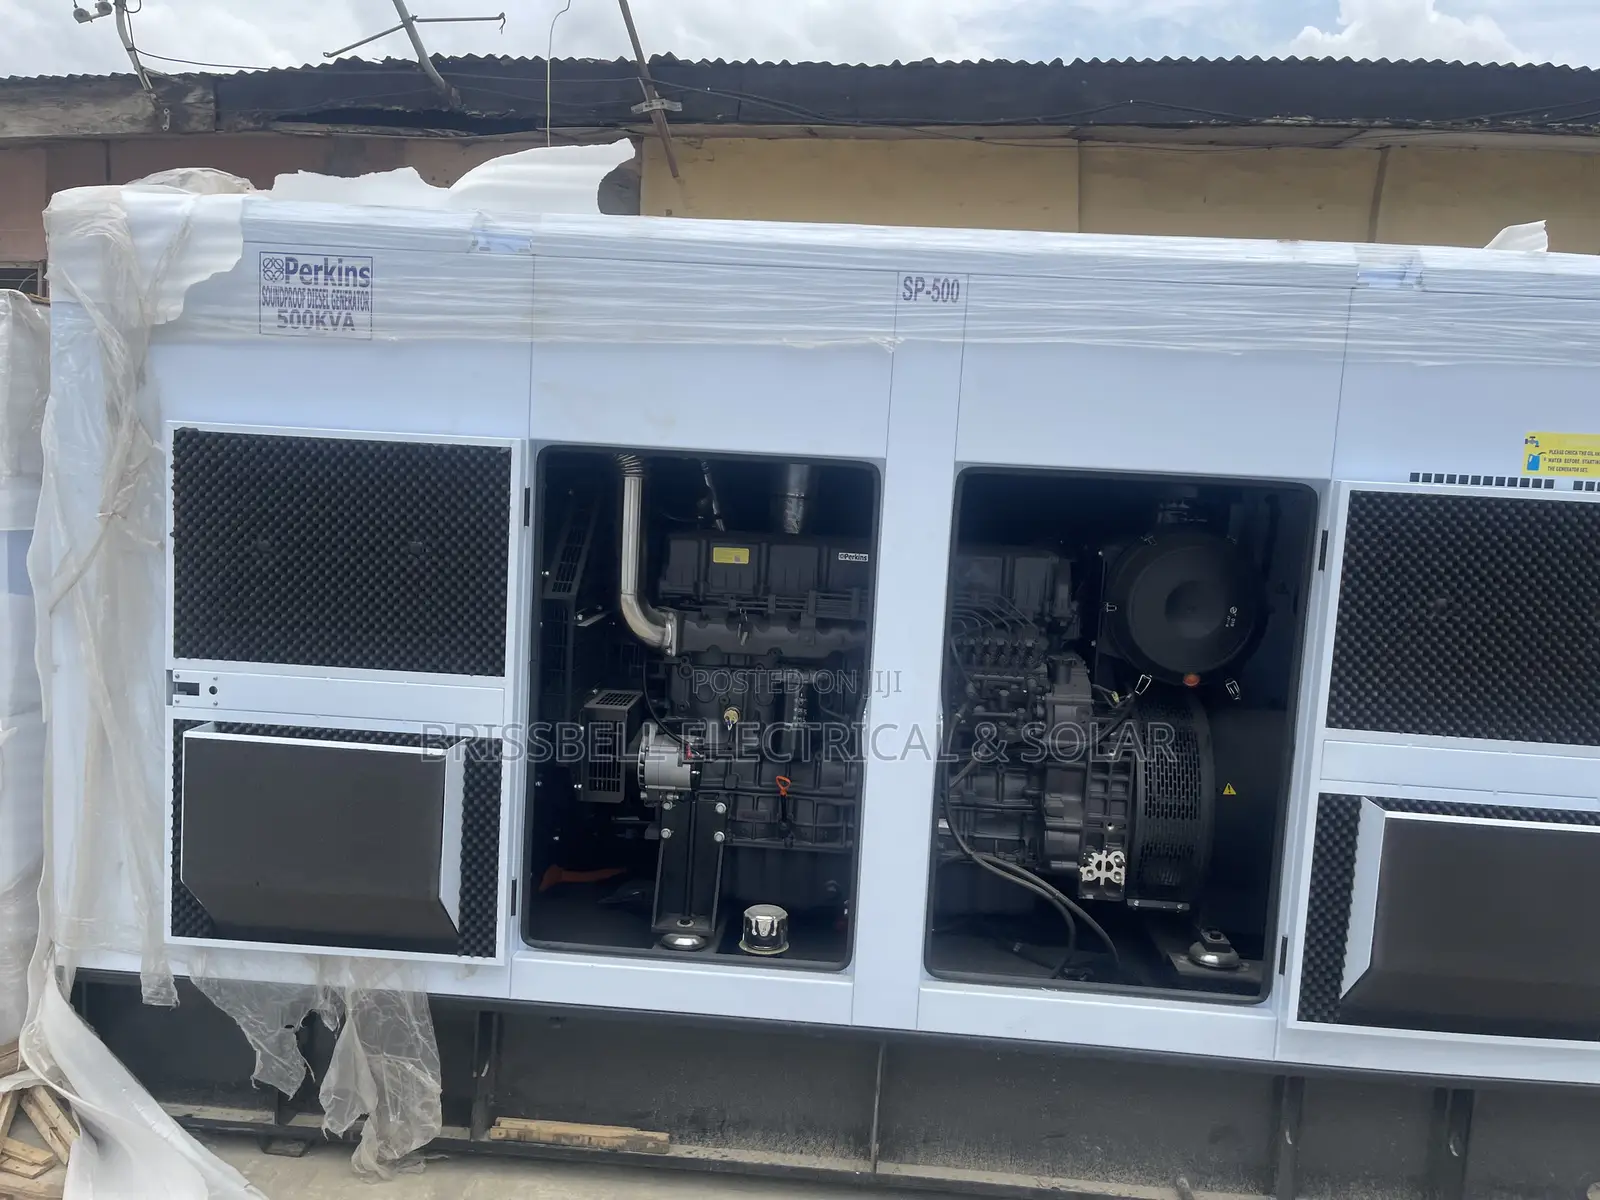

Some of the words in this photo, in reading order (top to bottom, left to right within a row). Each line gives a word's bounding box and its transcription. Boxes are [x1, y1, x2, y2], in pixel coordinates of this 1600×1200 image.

[284, 257, 370, 287] Perkins
[261, 285, 306, 309] SOUNDPROOF
[307, 287, 330, 310] DIESEL
[331, 289, 370, 312] GENERATOR
[902, 276, 960, 303] SP-500
[277, 309, 355, 331] 500KVA
[844, 553, 868, 561] Perkins
